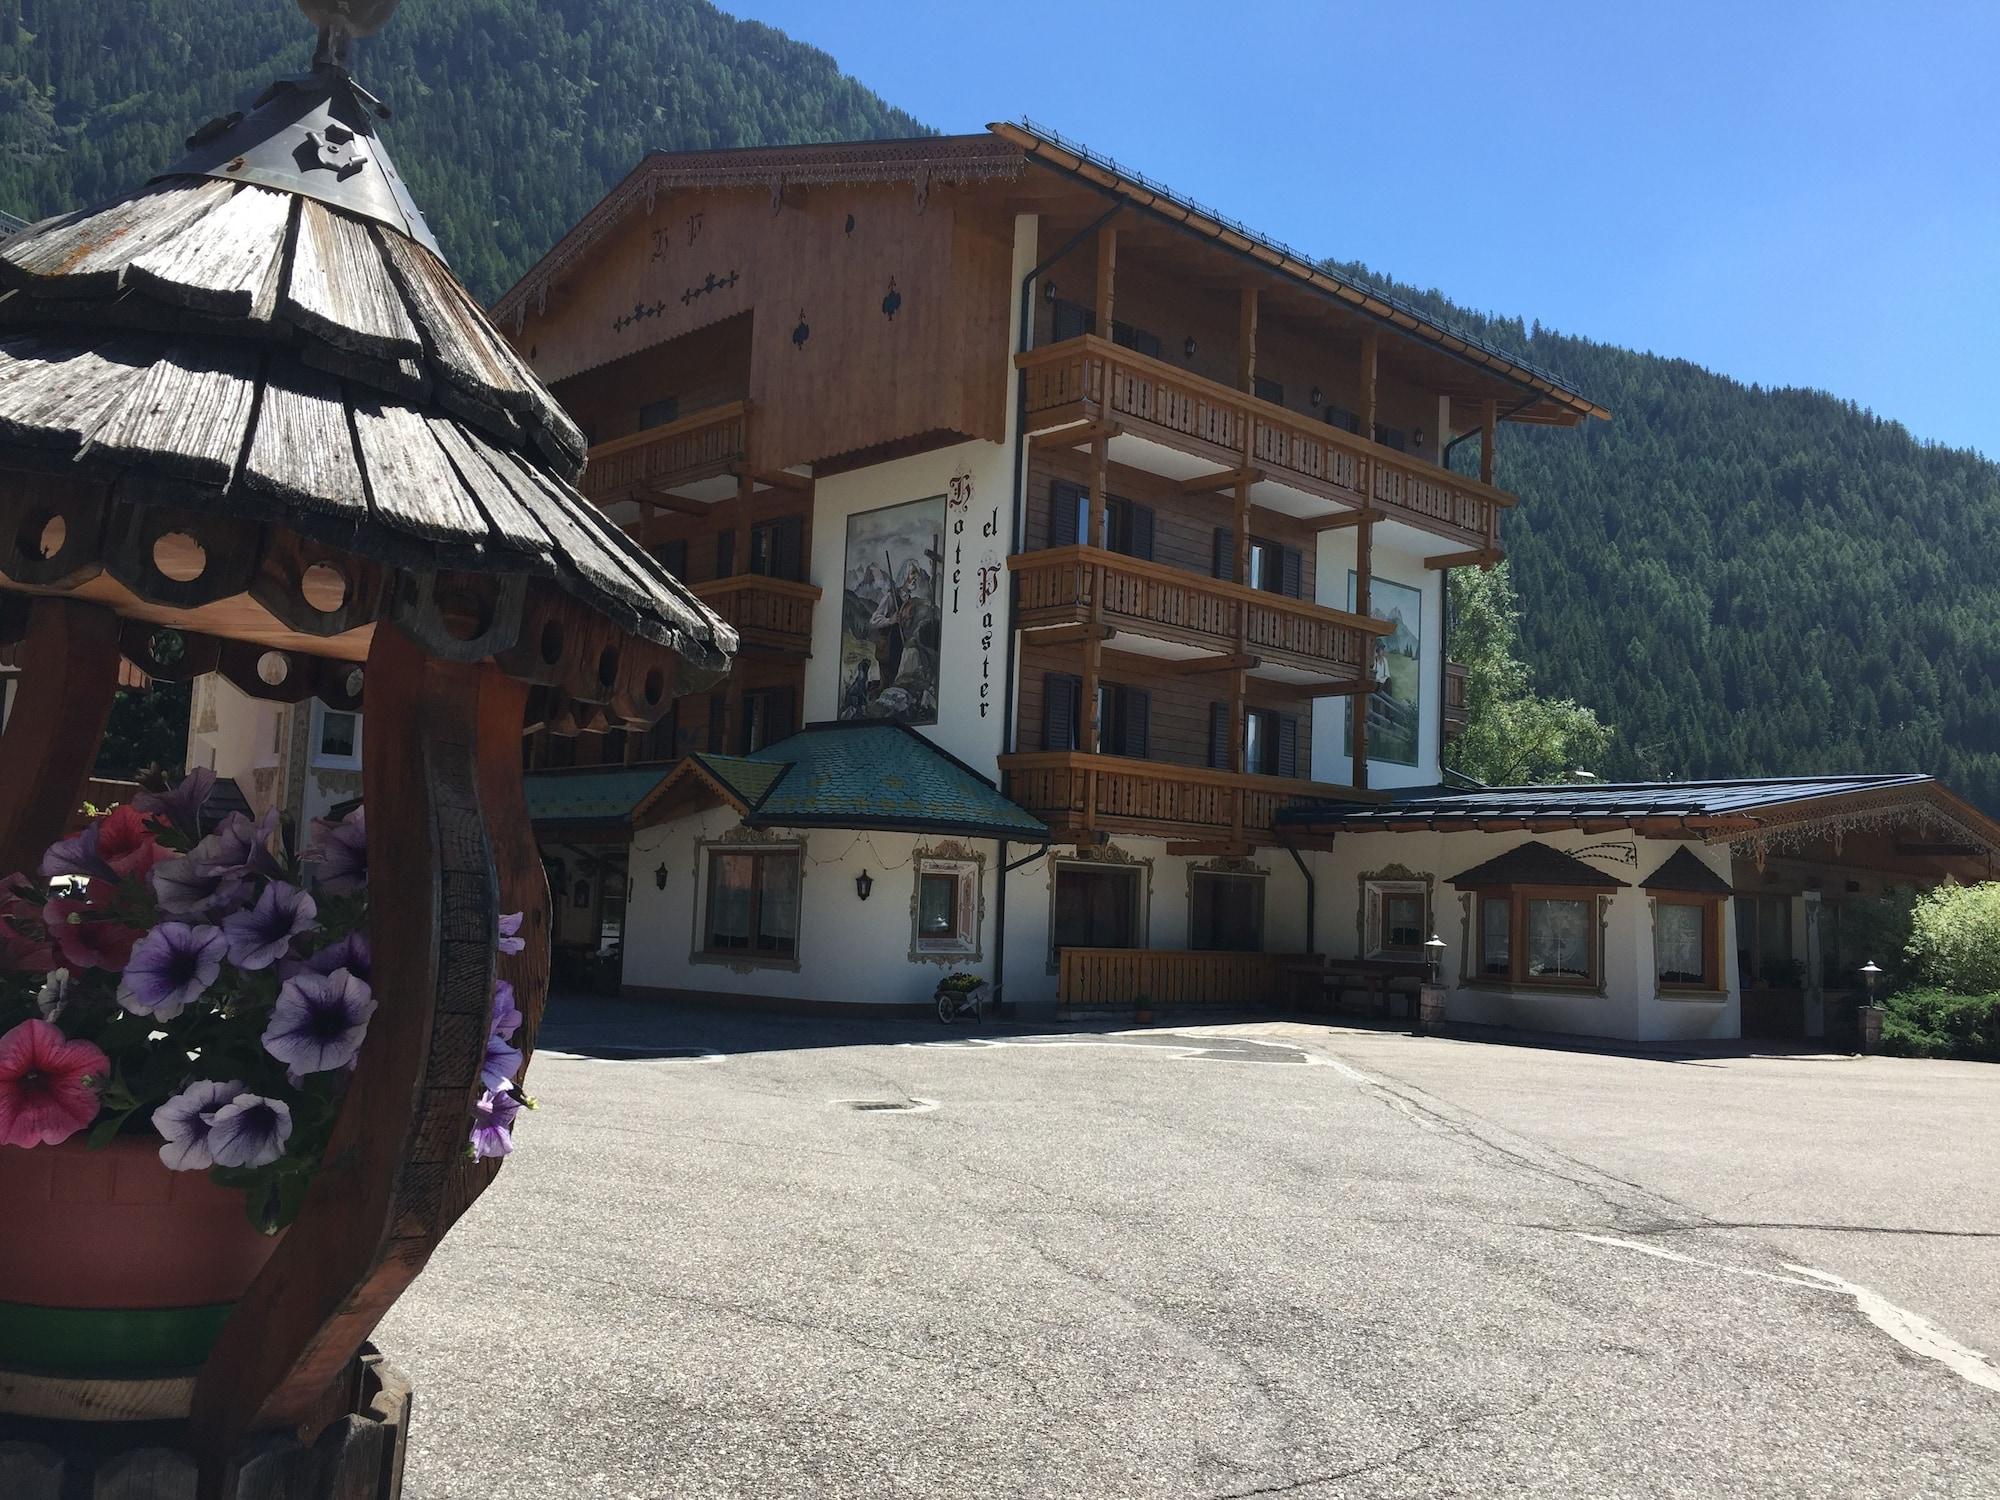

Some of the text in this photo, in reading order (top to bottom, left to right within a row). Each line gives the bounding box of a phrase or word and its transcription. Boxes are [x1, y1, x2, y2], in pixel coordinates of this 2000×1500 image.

[949, 474, 971, 614] Hotel
[976, 506, 1001, 718] el Paster
